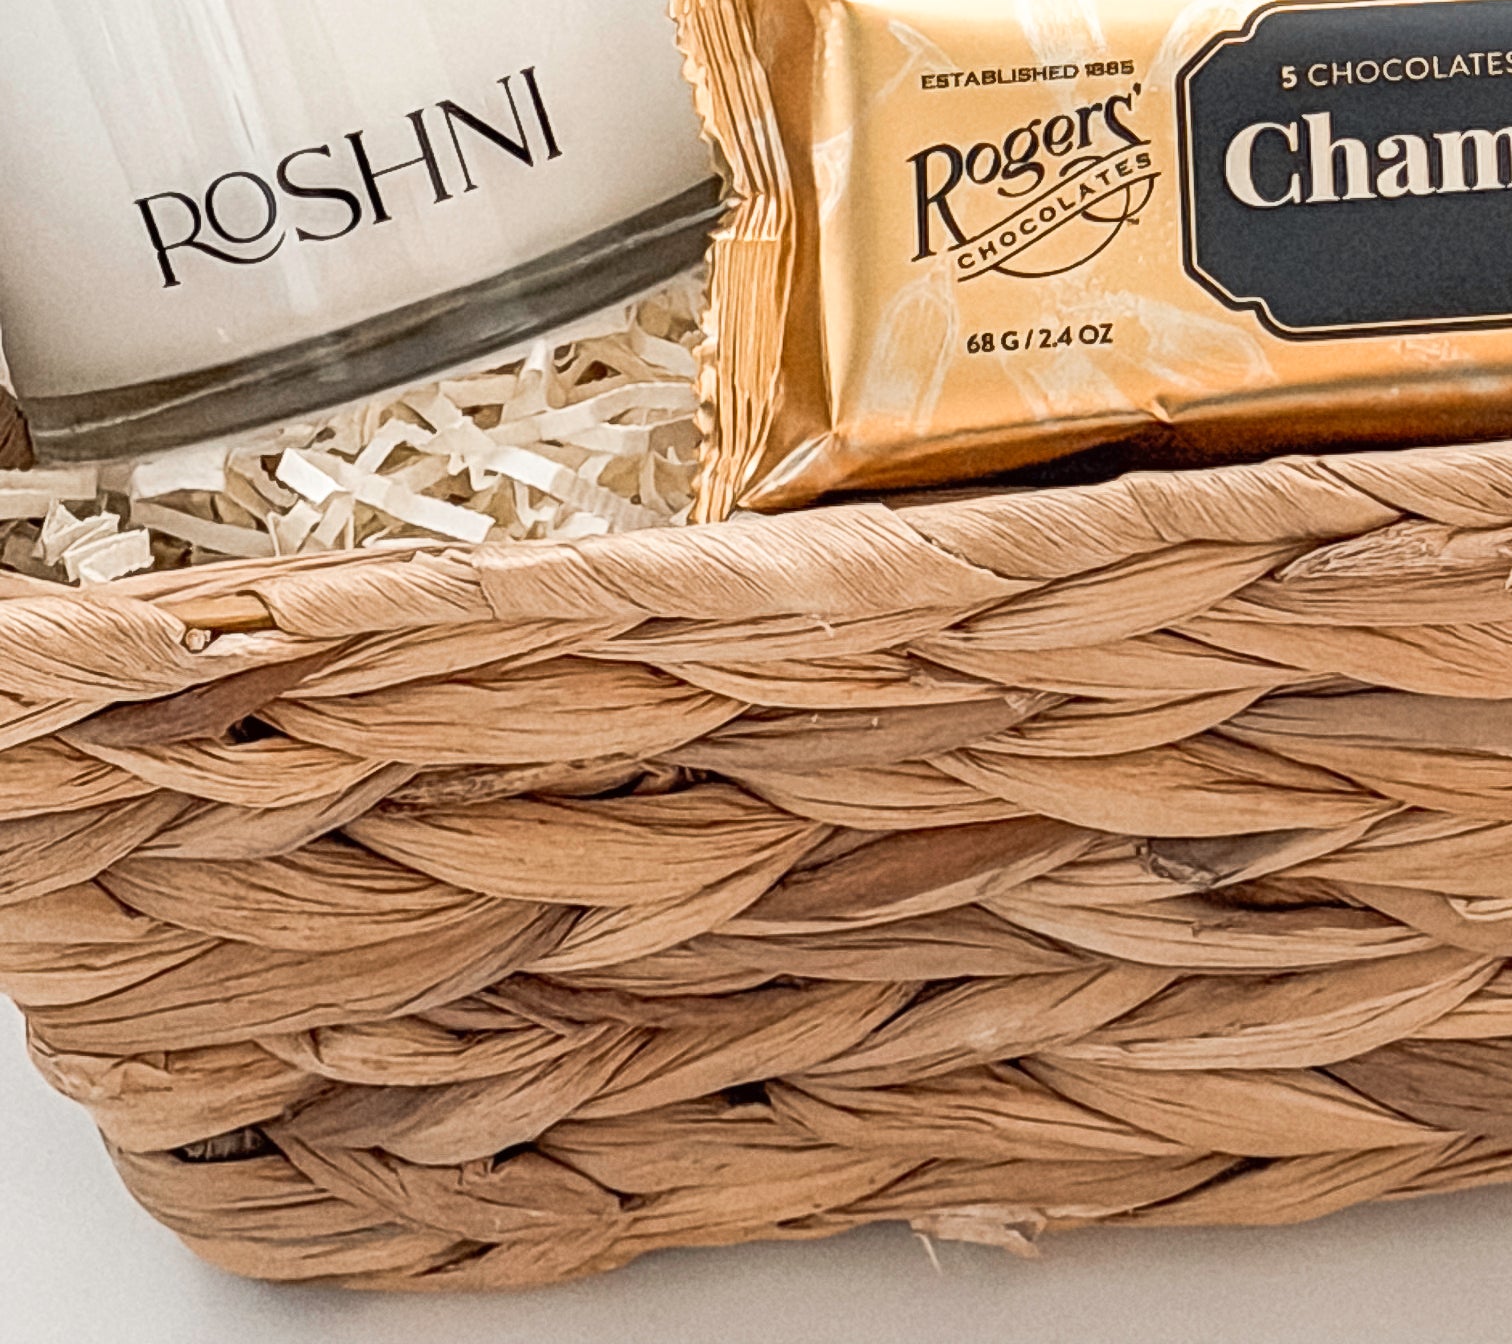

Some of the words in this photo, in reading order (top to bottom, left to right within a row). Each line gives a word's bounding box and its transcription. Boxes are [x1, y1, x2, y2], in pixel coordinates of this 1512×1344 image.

[921, 64, 1079, 90] ESTABLISHED
[1280, 66, 1299, 88] 5
[133, 66, 563, 289] ROSHNI
[957, 152, 1152, 269] CHOCOLATES
[966, 332, 996, 354] 68
[1039, 326, 1073, 349] 2.4
[1078, 323, 1114, 345] OZ
